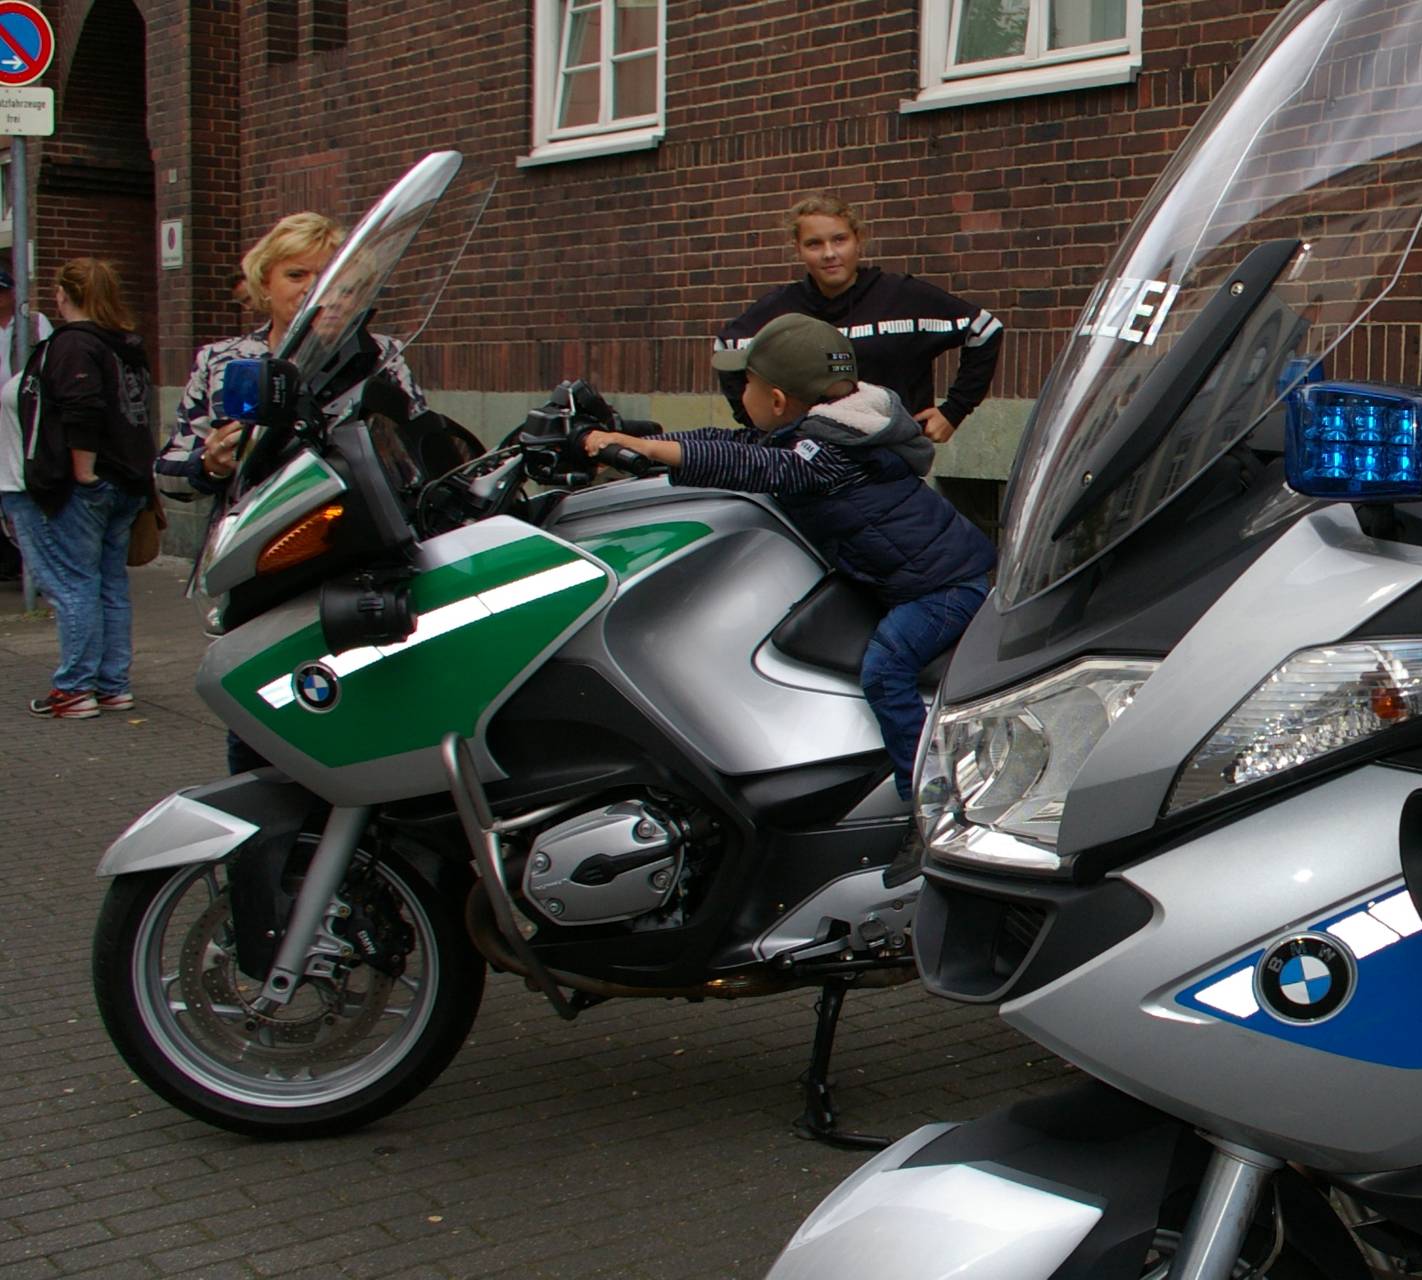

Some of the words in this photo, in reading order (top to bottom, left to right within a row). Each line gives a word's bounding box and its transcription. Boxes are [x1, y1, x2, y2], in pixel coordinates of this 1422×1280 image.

[877, 319, 915, 335] PUMA
[918, 318, 953, 332] PUMA
[1266, 940, 1337, 975] BMW
